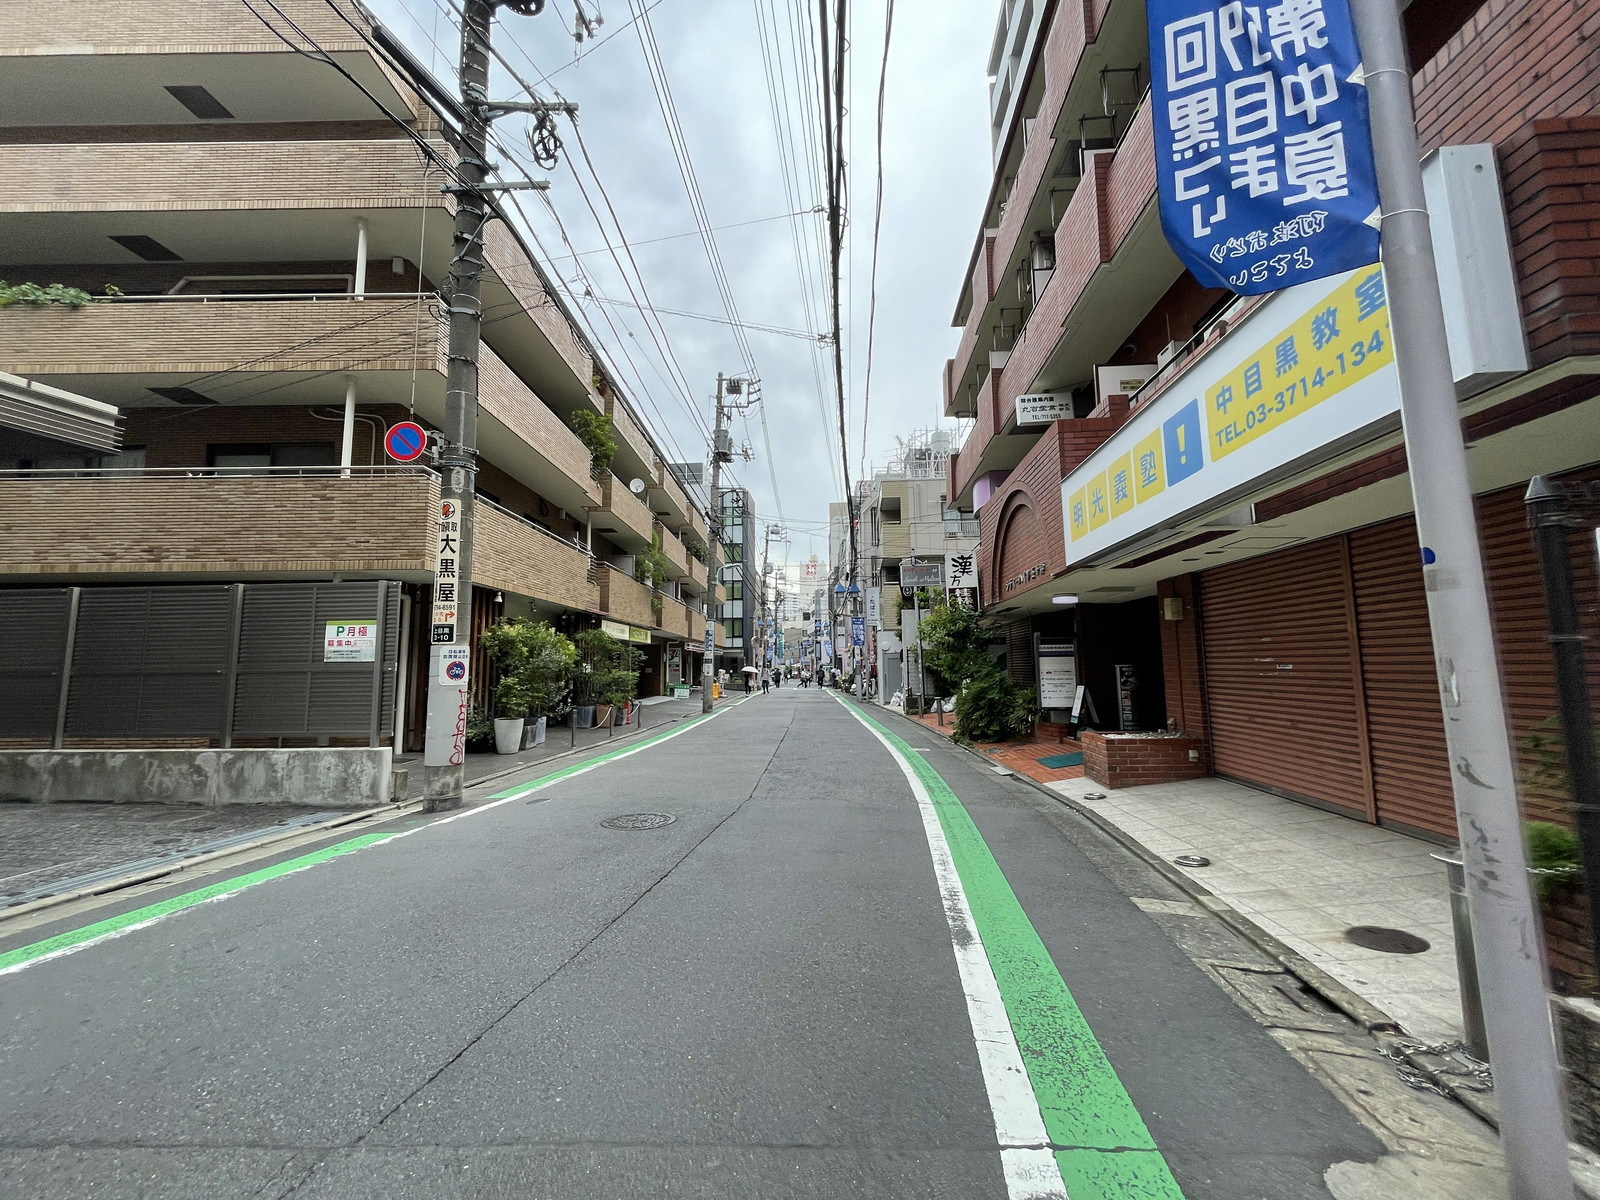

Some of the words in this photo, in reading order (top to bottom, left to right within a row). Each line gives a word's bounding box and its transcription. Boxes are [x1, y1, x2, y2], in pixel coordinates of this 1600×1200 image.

[1215, 273, 1387, 415] 中目黒教室
[438, 534, 457, 602] 大黒屋
[949, 554, 973, 586] 漢方
